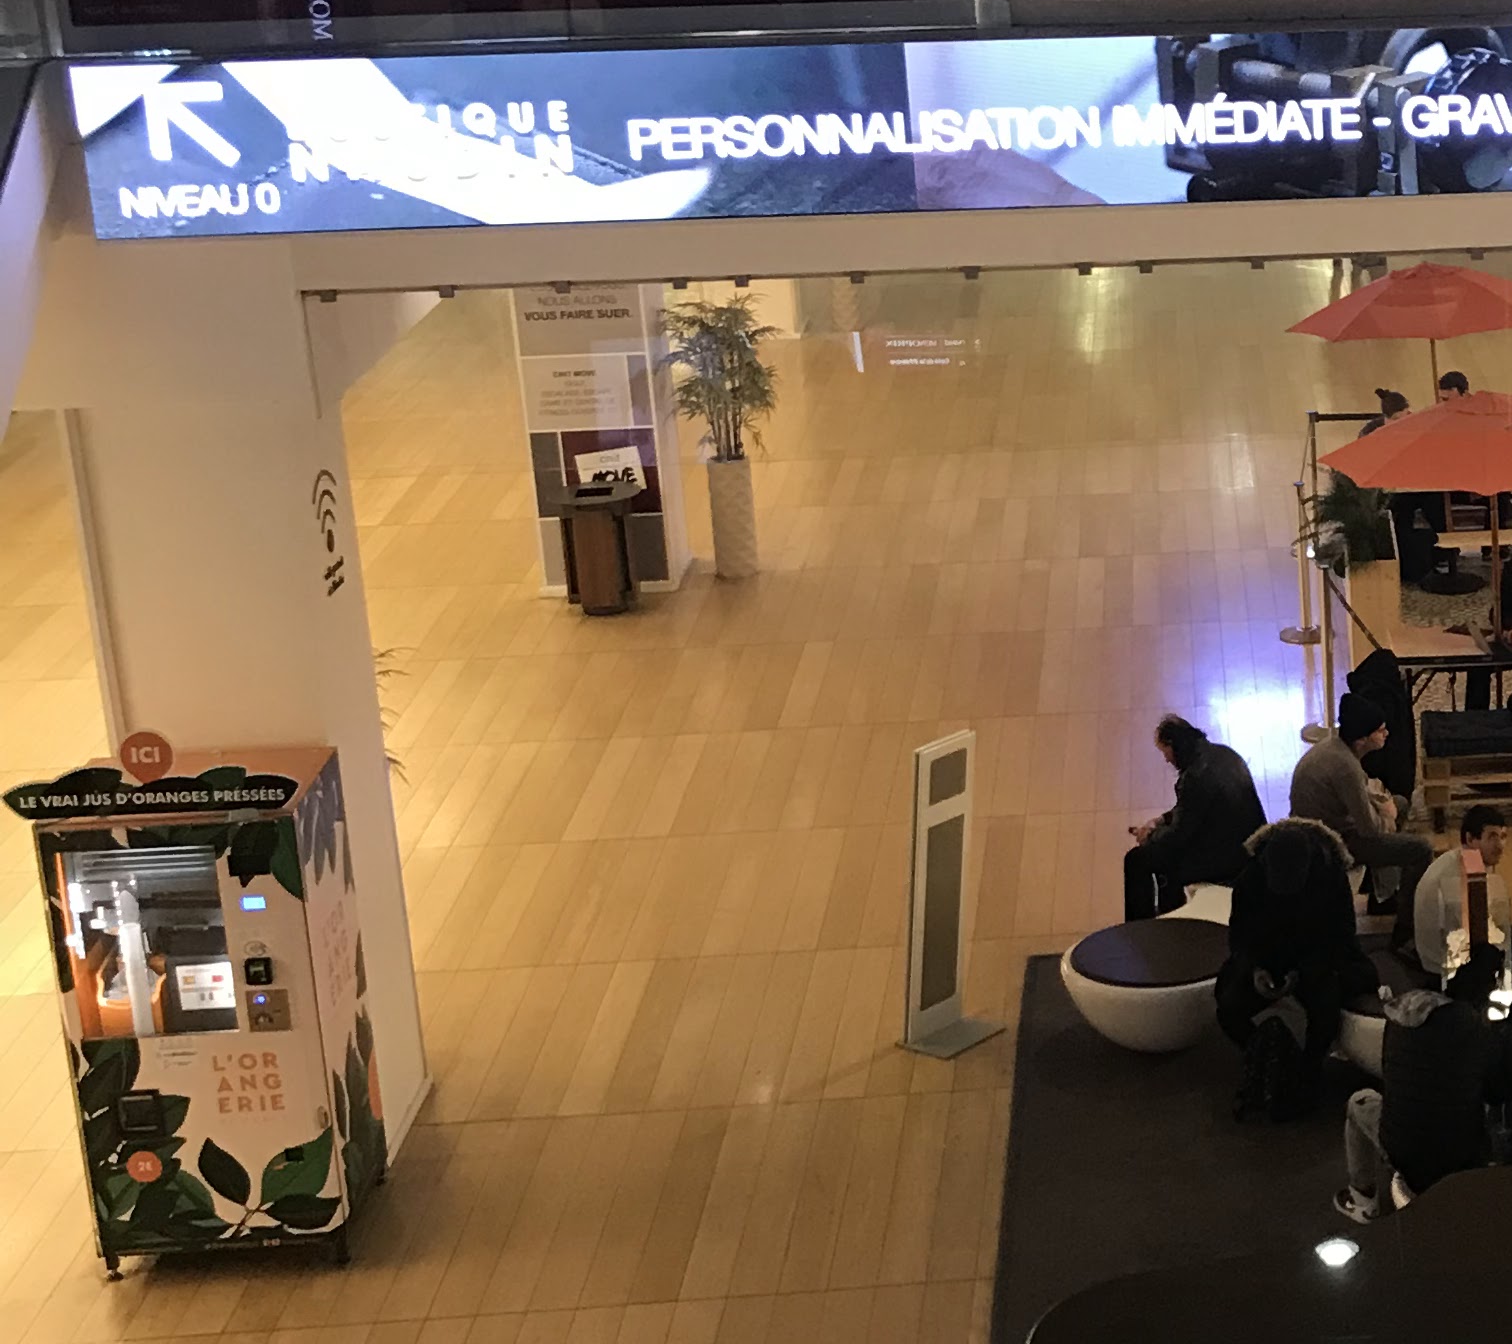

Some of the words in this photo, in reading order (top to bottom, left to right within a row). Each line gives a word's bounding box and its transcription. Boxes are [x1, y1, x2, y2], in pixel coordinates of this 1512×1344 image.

[627, 104, 1101, 160] PERSONNALISATION
[1112, 93, 1362, 146] IMMÉDIATE
[120, 187, 250, 219] NIVEAU
[523, 311, 558, 322] VOUS
[560, 309, 594, 320] FAIRE
[596, 308, 633, 319] SUER.
[592, 467, 638, 483] MOVE
[131, 747, 159, 764] ICI
[19, 797, 37, 809] LE
[40, 794, 79, 807] VRAI
[116, 790, 209, 805] D'ORANGES
[212, 1052, 279, 1072] L'OR
[217, 1073, 282, 1093] ANG
[218, 1093, 286, 1114] ERIE
